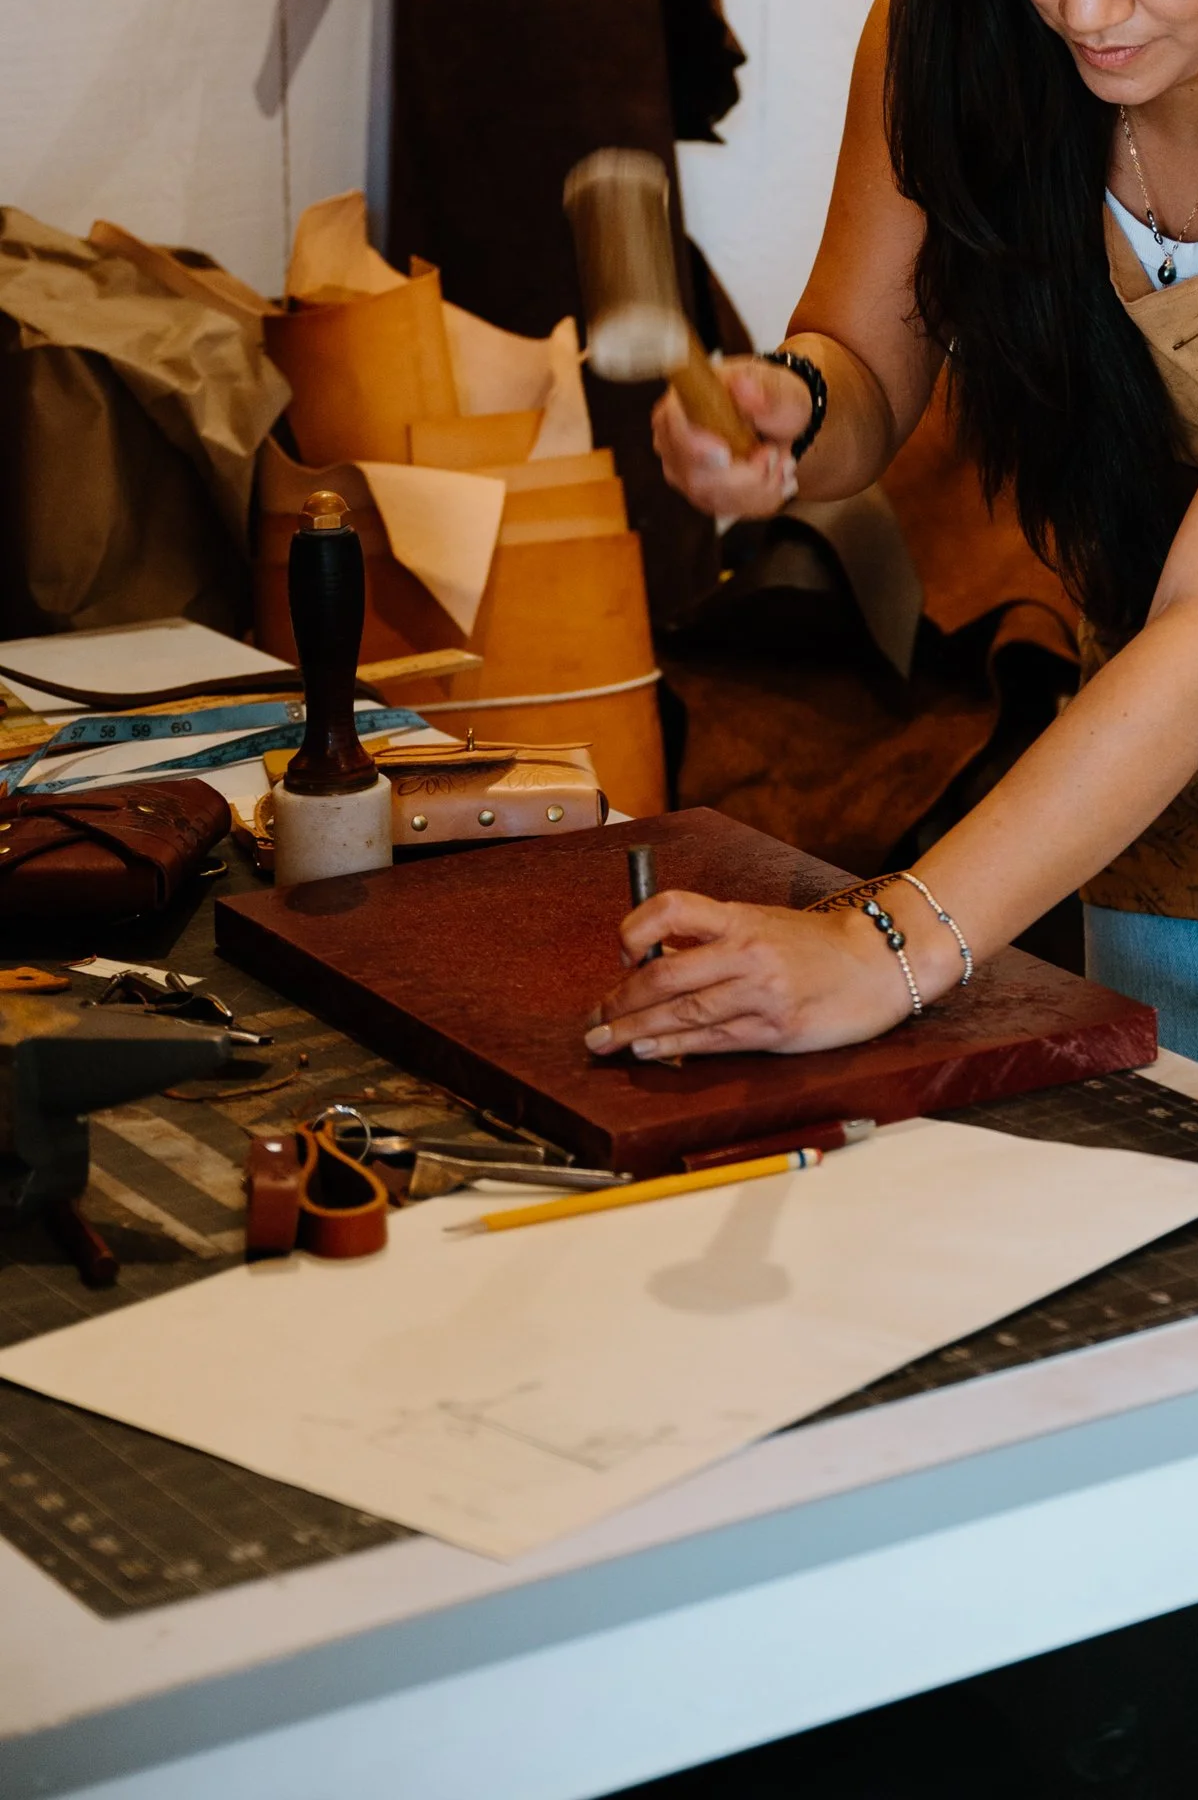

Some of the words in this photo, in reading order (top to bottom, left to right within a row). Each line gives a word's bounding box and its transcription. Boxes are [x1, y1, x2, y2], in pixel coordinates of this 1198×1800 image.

[70, 726, 87, 740] 57
[100, 725, 116, 738] 58
[131, 724, 151, 737] 59
[170, 720, 192, 733] 60
